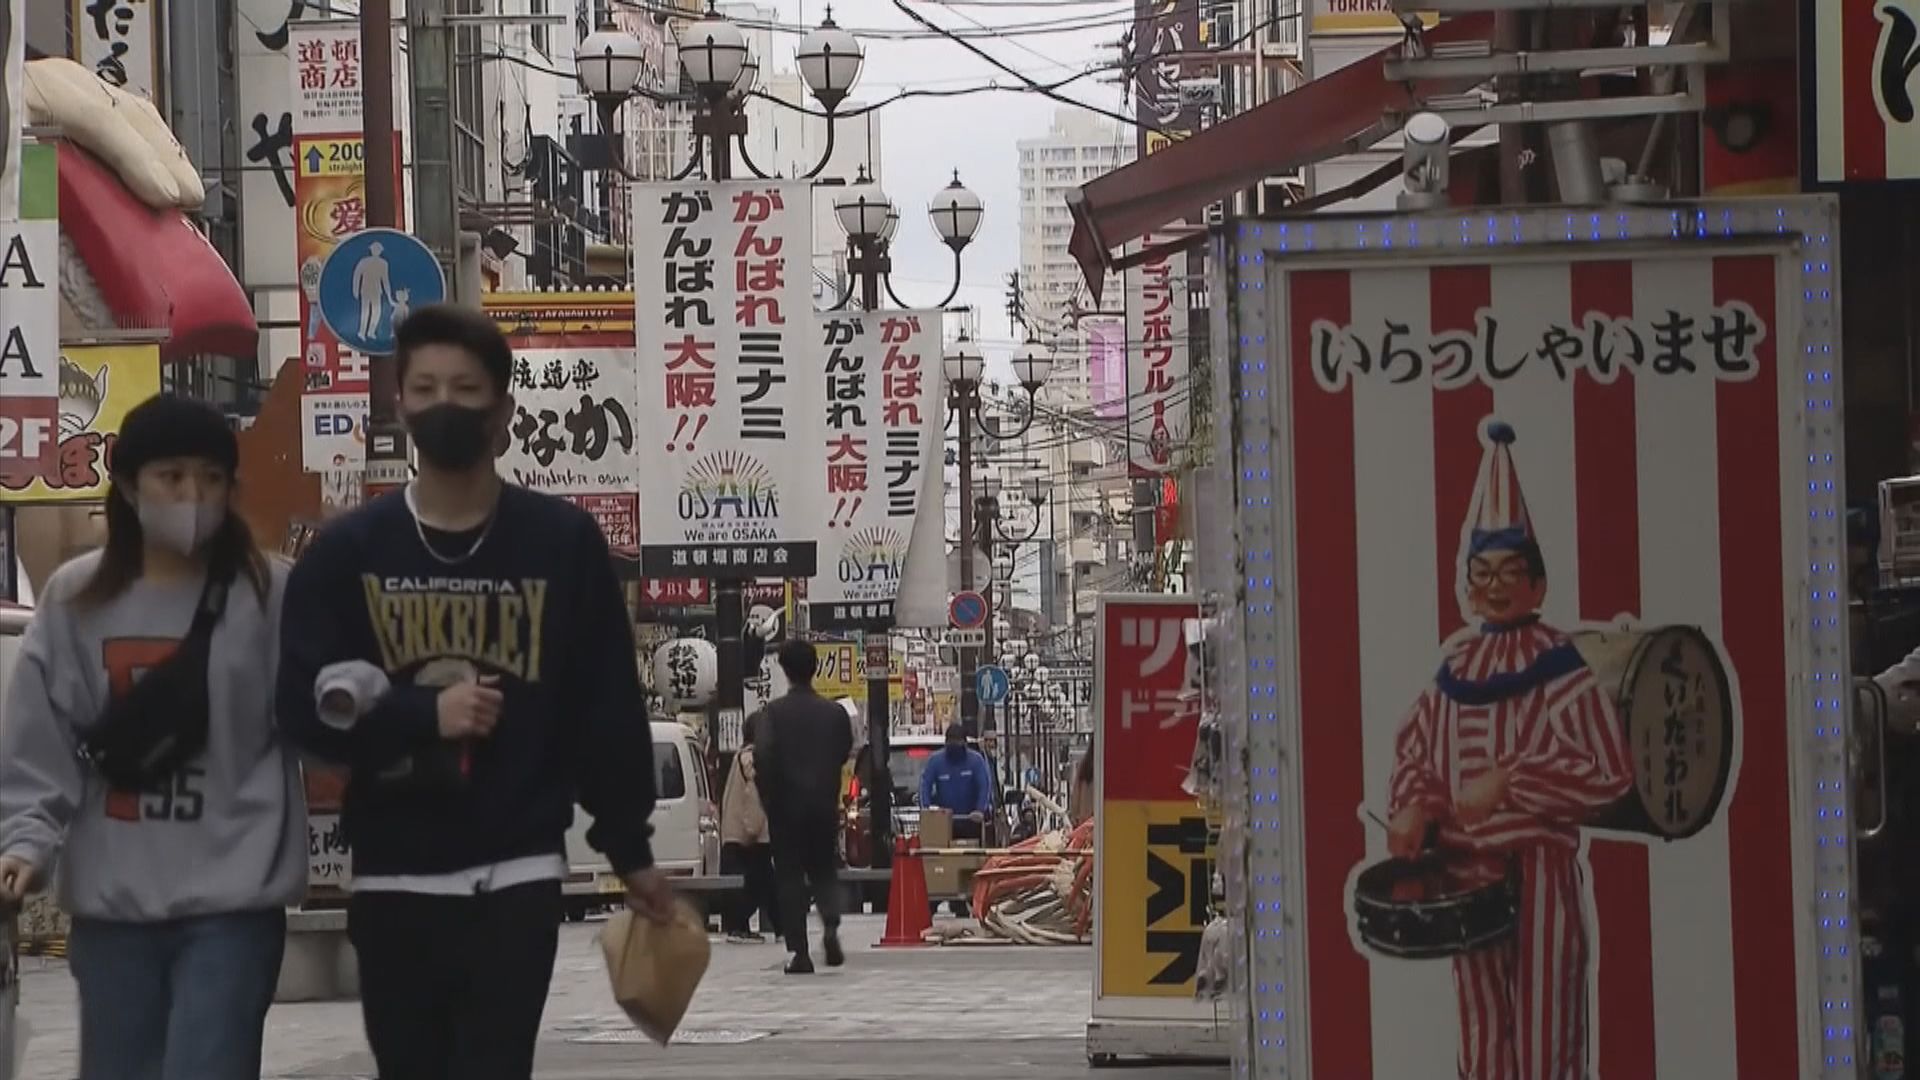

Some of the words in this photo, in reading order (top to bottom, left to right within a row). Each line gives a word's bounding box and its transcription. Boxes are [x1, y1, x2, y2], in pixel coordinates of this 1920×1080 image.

[299, 64, 359, 90] 商店
[732, 188, 786, 440] がんばれミナミ
[1317, 309, 1759, 386] いらっしゃいませ
[0, 418, 50, 457] 2F
[879, 316, 922, 518] がんばれミナミ
[678, 470, 780, 520] OSAKA
[684, 529, 705, 541] We
[709, 530, 729, 541] are
[732, 526, 777, 540] OSAKA
[672, 548, 789, 567] 道頓堀商店会
[385, 577, 515, 593] CALIFORNIA
[362, 573, 548, 682] BERKELEY
